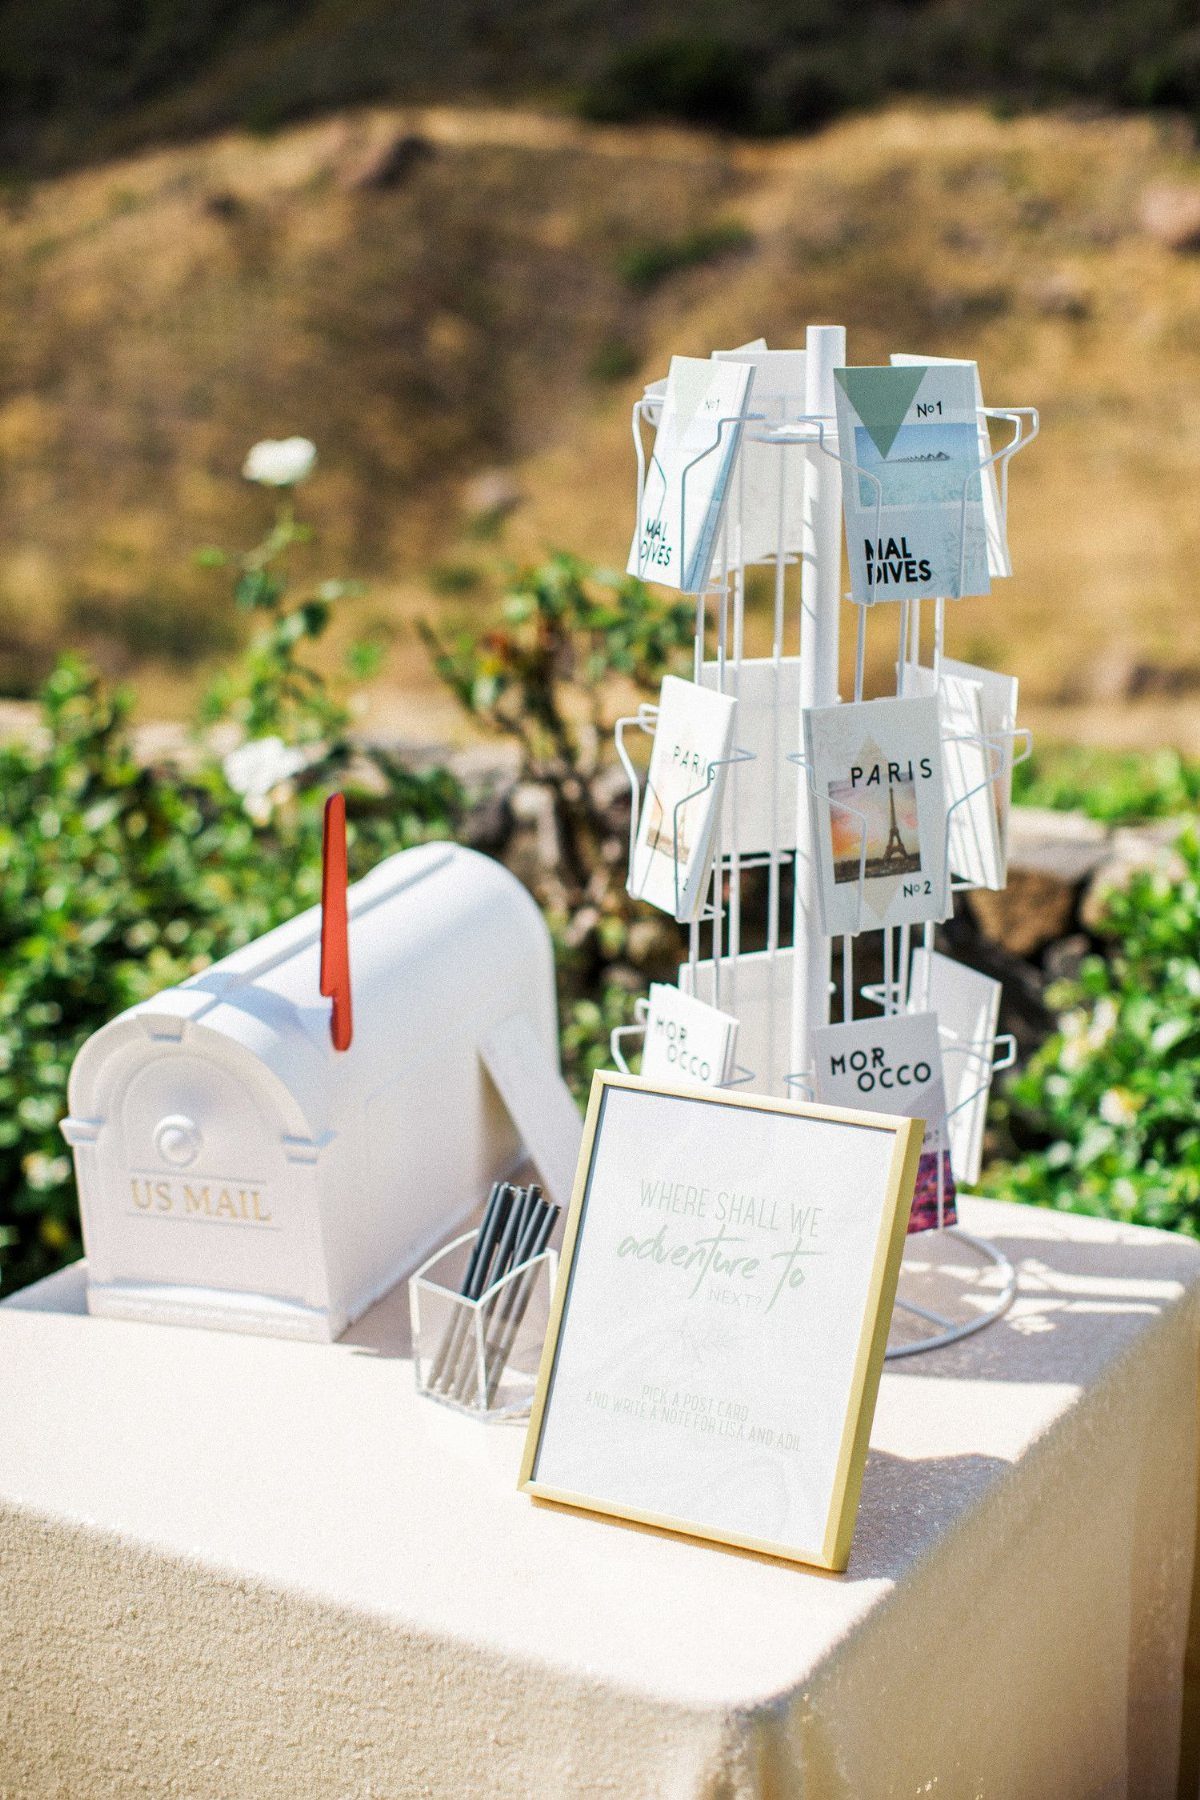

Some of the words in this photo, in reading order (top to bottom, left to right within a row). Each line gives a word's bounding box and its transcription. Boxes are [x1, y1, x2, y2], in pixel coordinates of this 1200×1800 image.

[640, 541, 672, 566] DIVES
[864, 537, 913, 561] MAL
[866, 559, 932, 586] DIVES
[850, 758, 933, 788] PARIS
[656, 1017, 687, 1044] MOR
[667, 1044, 711, 1081] OCCO
[831, 1047, 885, 1076] MOR
[857, 1062, 931, 1092] OCCO
[130, 1177, 173, 1211] US
[183, 1184, 272, 1222] MAIL
[640, 1178, 710, 1219] WHERE
[714, 1191, 779, 1232] SHALL
[790, 1202, 823, 1238] WE
[616, 1223, 761, 1300] adventure
[764, 1236, 826, 1314] to
[708, 1287, 763, 1309] NEXT?
[641, 1384, 668, 1405] PICK
[671, 1391, 679, 1407] A
[683, 1392, 714, 1414] POST
[717, 1400, 750, 1423] CARD
[585, 1391, 608, 1410] AND
[612, 1395, 646, 1420] WRITE
[650, 1406, 658, 1421] A
[661, 1407, 690, 1429] NOTE
[694, 1414, 716, 1434] FOR
[719, 1418, 744, 1441] LISA
[748, 1425, 774, 1447] AND
[776, 1431, 801, 1452] ADIL
